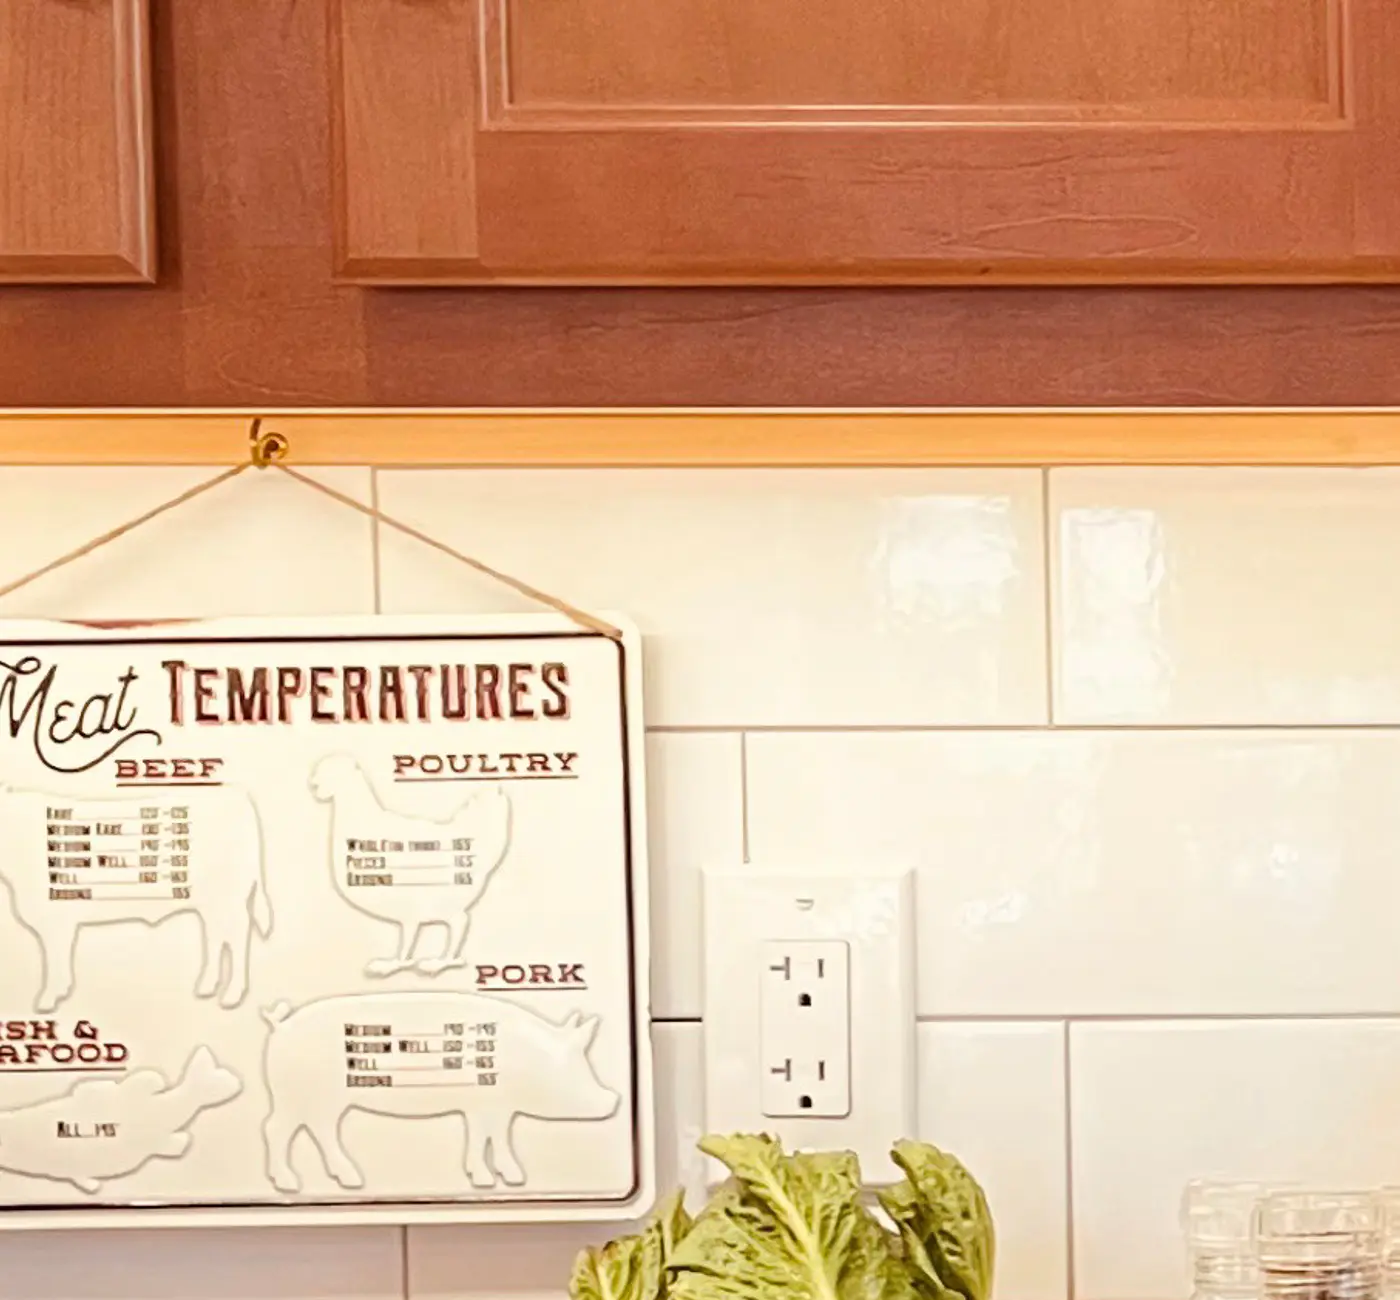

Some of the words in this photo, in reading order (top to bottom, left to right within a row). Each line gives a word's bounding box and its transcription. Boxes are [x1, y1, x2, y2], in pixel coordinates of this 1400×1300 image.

[0, 656, 162, 773] Meat
[161, 660, 572, 726] TEMPERATURES
[114, 758, 224, 779] BEEF
[392, 752, 579, 775] POULTRY
[475, 963, 585, 984] PORK
[74, 1020, 98, 1040] &
